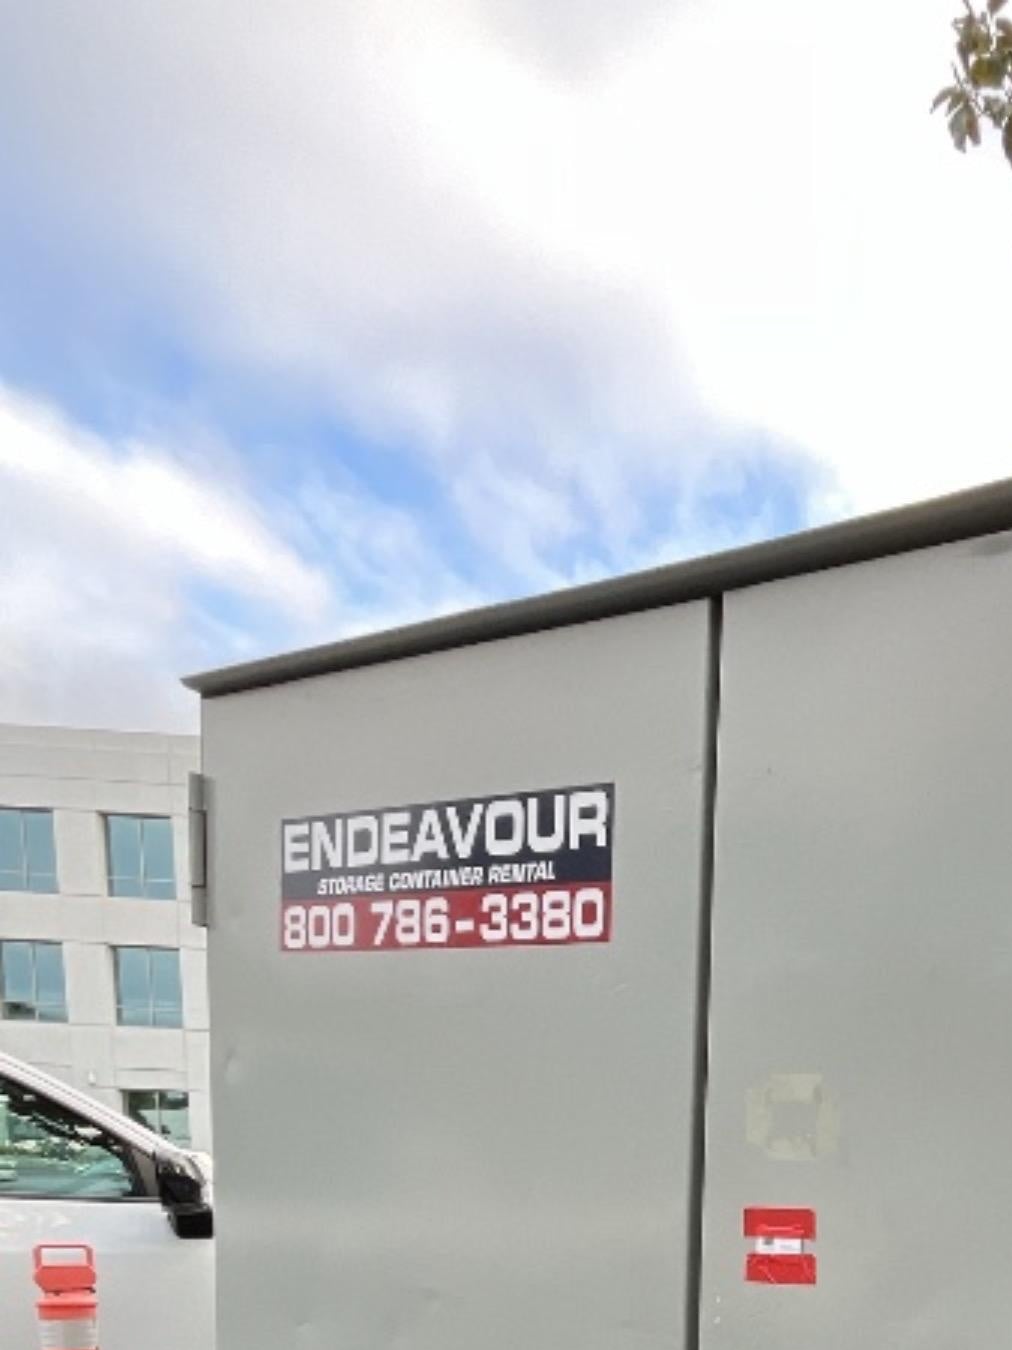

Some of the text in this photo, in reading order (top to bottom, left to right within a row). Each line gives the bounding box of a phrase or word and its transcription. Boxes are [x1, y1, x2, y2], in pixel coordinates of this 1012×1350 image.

[283, 791, 607, 872] ENDEAVOUR
[317, 860, 556, 895] STORAGE CONTAINER RENTAL
[283, 888, 604, 950] 800 786-3380
